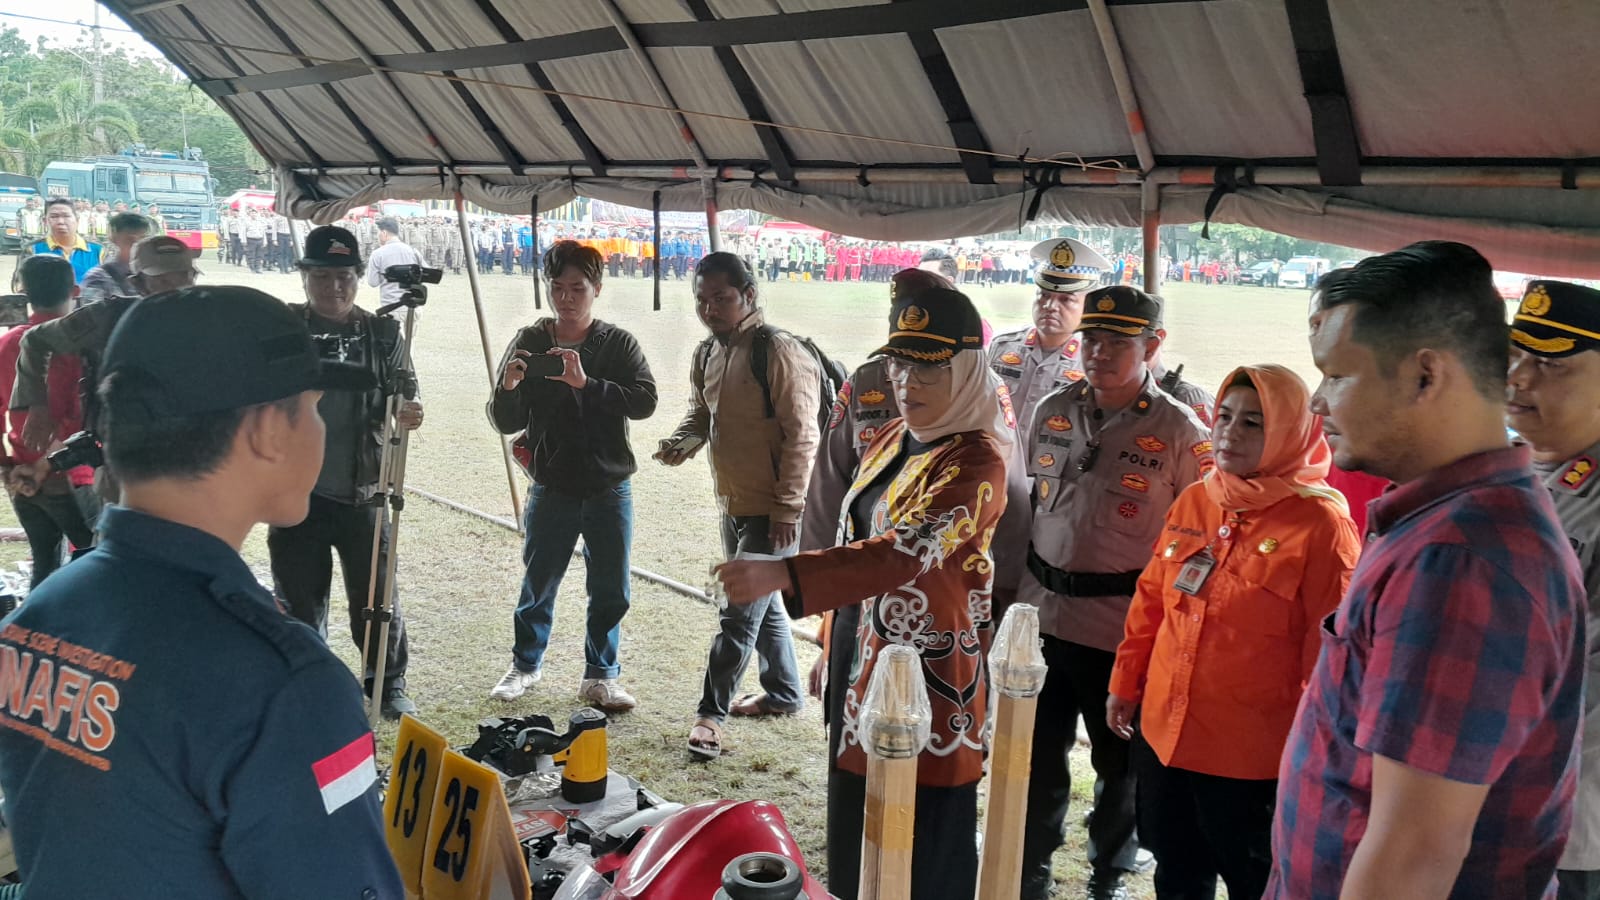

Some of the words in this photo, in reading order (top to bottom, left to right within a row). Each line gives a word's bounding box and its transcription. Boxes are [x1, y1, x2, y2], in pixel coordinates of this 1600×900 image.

[47, 185, 69, 197] POLISI
[1119, 451, 1164, 472] POLRI
[393, 740, 427, 838] 13
[433, 777, 480, 882] 25
